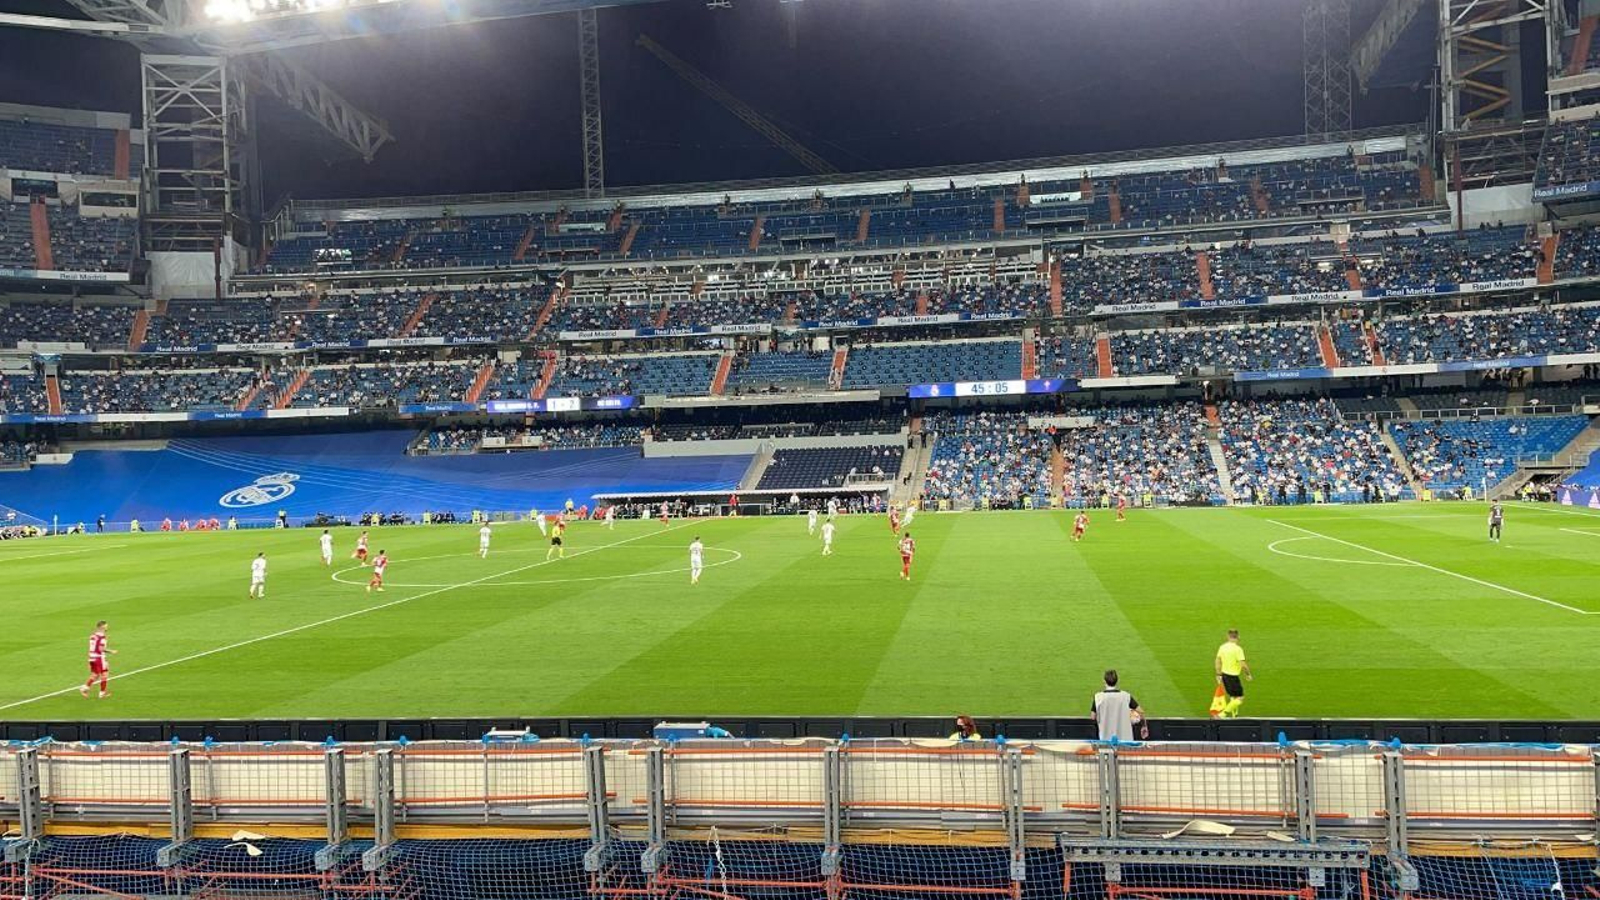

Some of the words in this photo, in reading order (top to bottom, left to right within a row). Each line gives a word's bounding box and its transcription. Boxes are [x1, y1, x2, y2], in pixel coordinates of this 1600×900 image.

[1556, 184, 1587, 194] Madrid
[1472, 283, 1491, 291] Real
[1493, 280, 1525, 288] Madrid
[1386, 288, 1404, 296] Real
[1407, 286, 1435, 294] Madrid
[1130, 303, 1156, 311] Madrid
[1220, 298, 1245, 306] Madrid
[971, 384, 985, 394] 45
[995, 383, 1009, 393] 05
